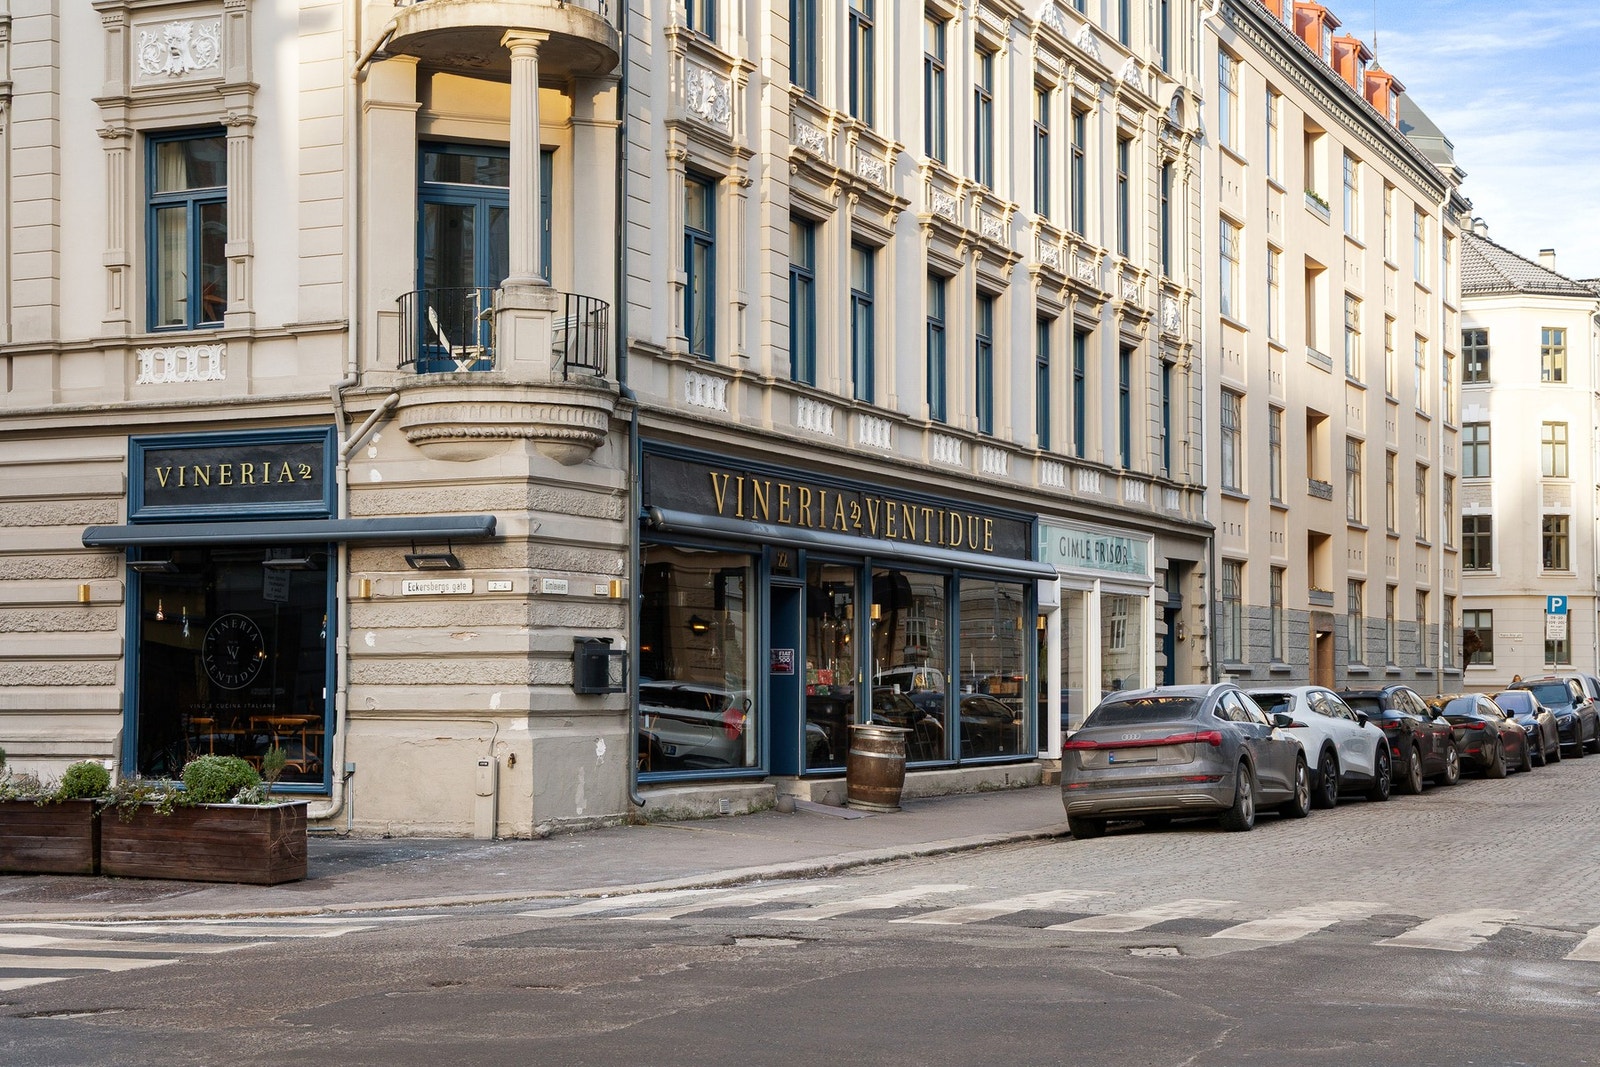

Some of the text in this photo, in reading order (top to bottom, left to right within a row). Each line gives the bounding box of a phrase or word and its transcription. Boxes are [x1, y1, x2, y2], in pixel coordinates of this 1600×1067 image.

[155, 461, 295, 488] VINERIA
[709, 471, 849, 532] VINERIA
[865, 497, 995, 553] VENTIDUE
[1059, 536, 1129, 566] GIMLE FRISØR
[408, 582, 467, 593] Eckersbergs gate
[1551, 597, 1563, 613] P
[207, 618, 259, 642] VINERIA
[206, 654, 260, 684] VENTIDUE
